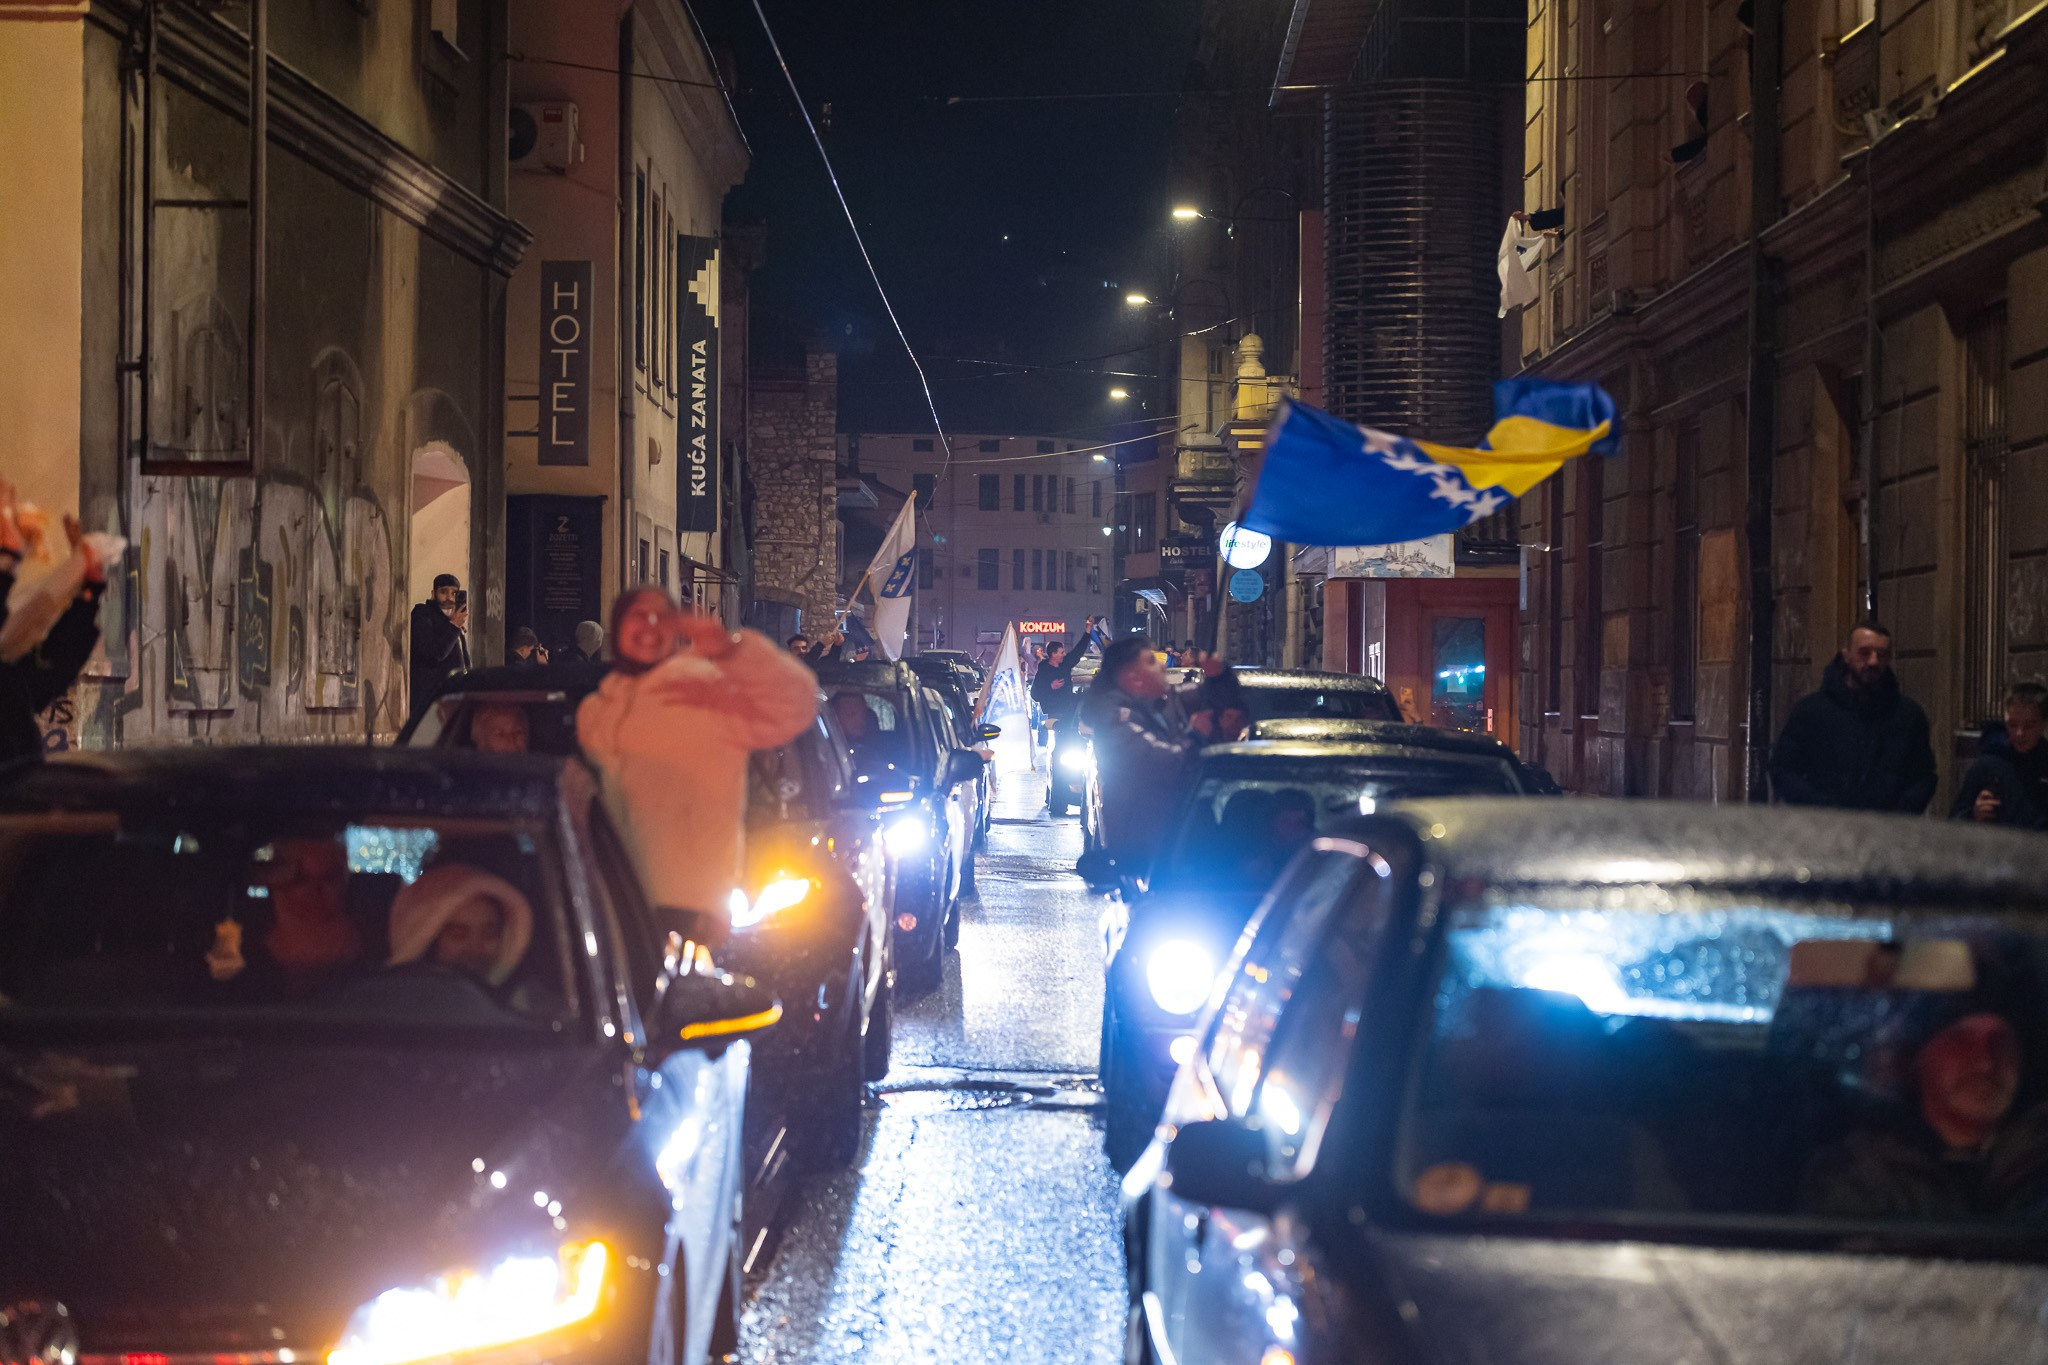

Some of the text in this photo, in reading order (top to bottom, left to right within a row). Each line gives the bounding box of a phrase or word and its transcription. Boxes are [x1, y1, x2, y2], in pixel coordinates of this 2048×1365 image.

[550, 281, 580, 446] HOTEL
[686, 339, 707, 497] KUĆA ZANATA
[1161, 546, 1213, 557] HOSTEL
[1019, 621, 1066, 633] KONZUM
